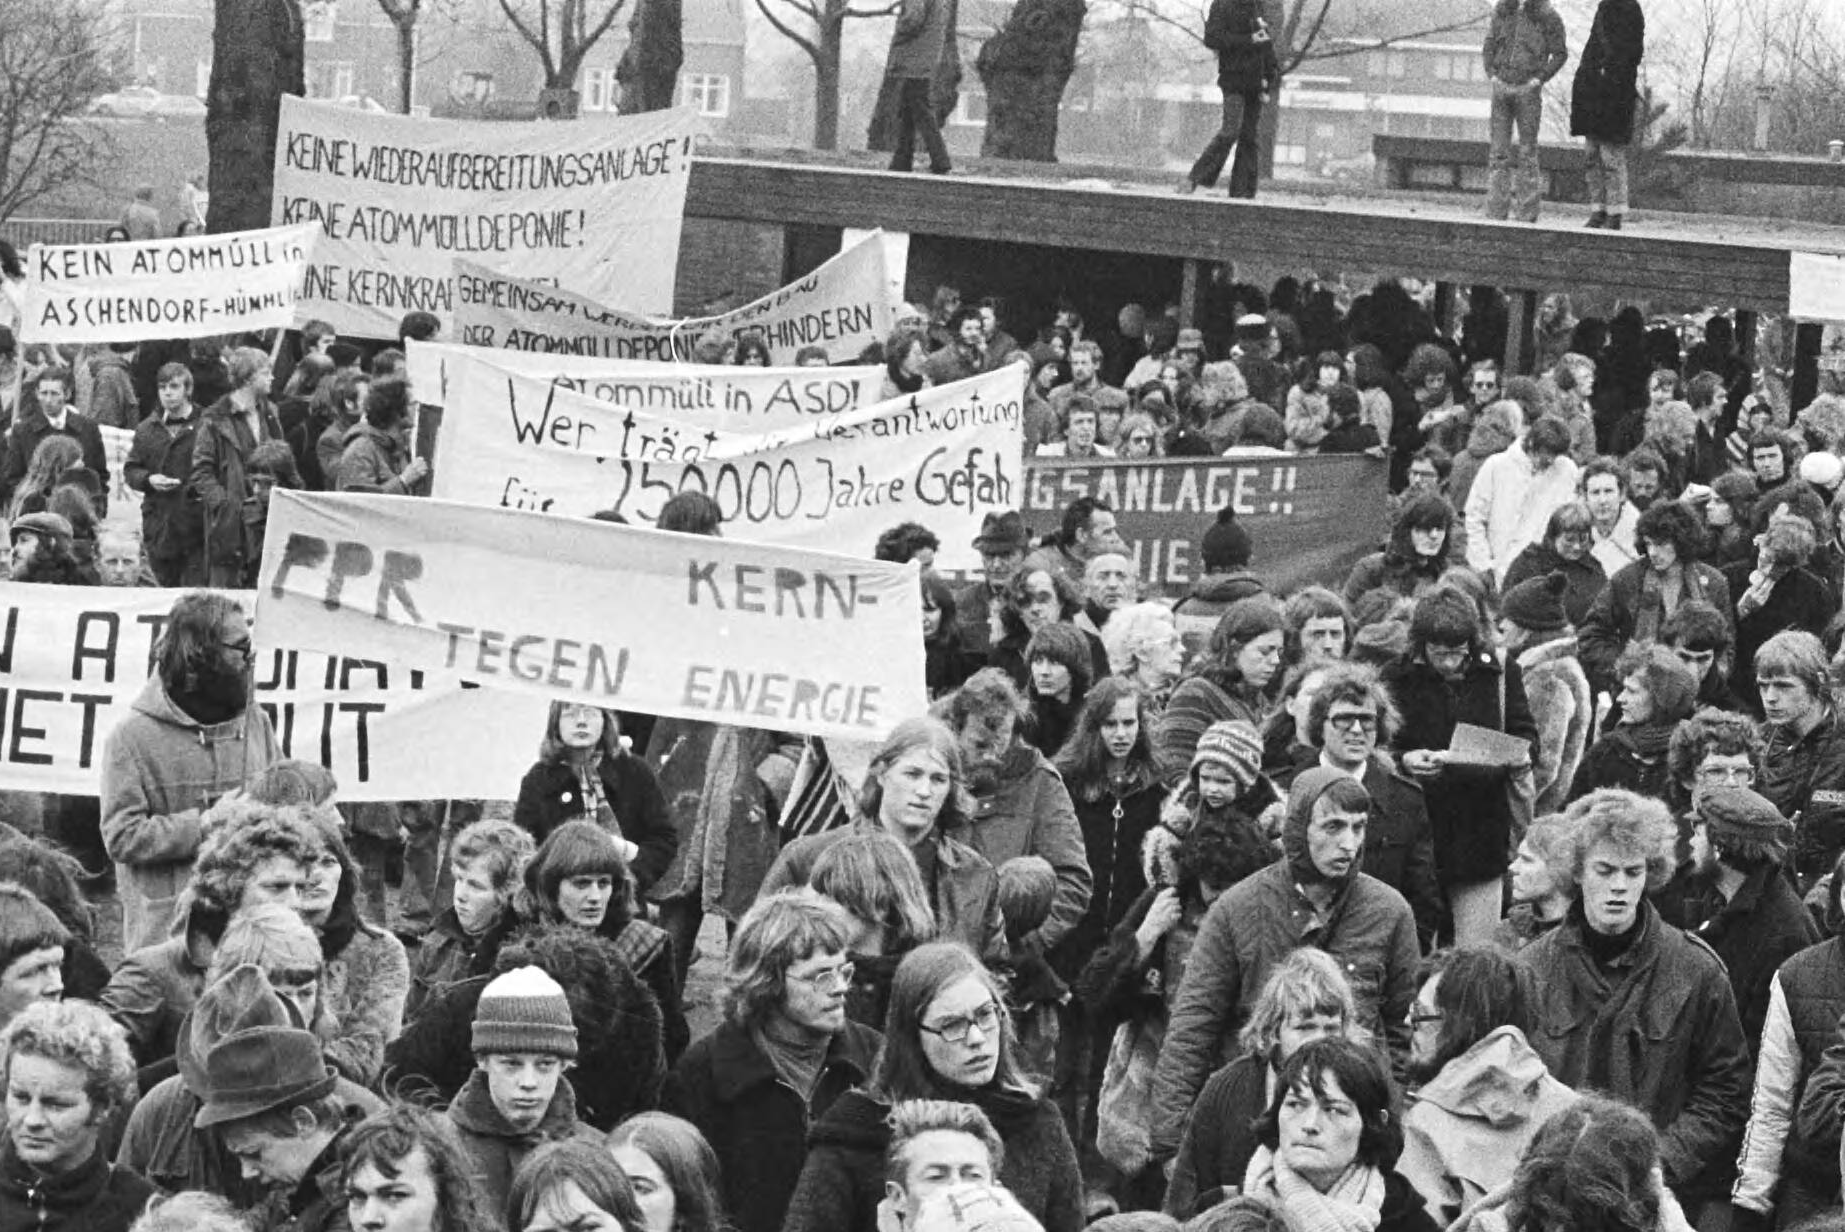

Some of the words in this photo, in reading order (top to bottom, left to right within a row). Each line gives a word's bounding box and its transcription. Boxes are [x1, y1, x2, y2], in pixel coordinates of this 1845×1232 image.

[287, 130, 348, 176] KEINE
[39, 250, 113, 282] KEIN
[131, 238, 274, 274] ATOMMÜLL
[508, 376, 597, 450] Wer
[724, 383, 752, 413] in
[806, 456, 905, 520] Jahre
[688, 558, 879, 620] KERN-
[436, 621, 630, 696] TEGEN
[683, 664, 882, 728] ENERGIE
